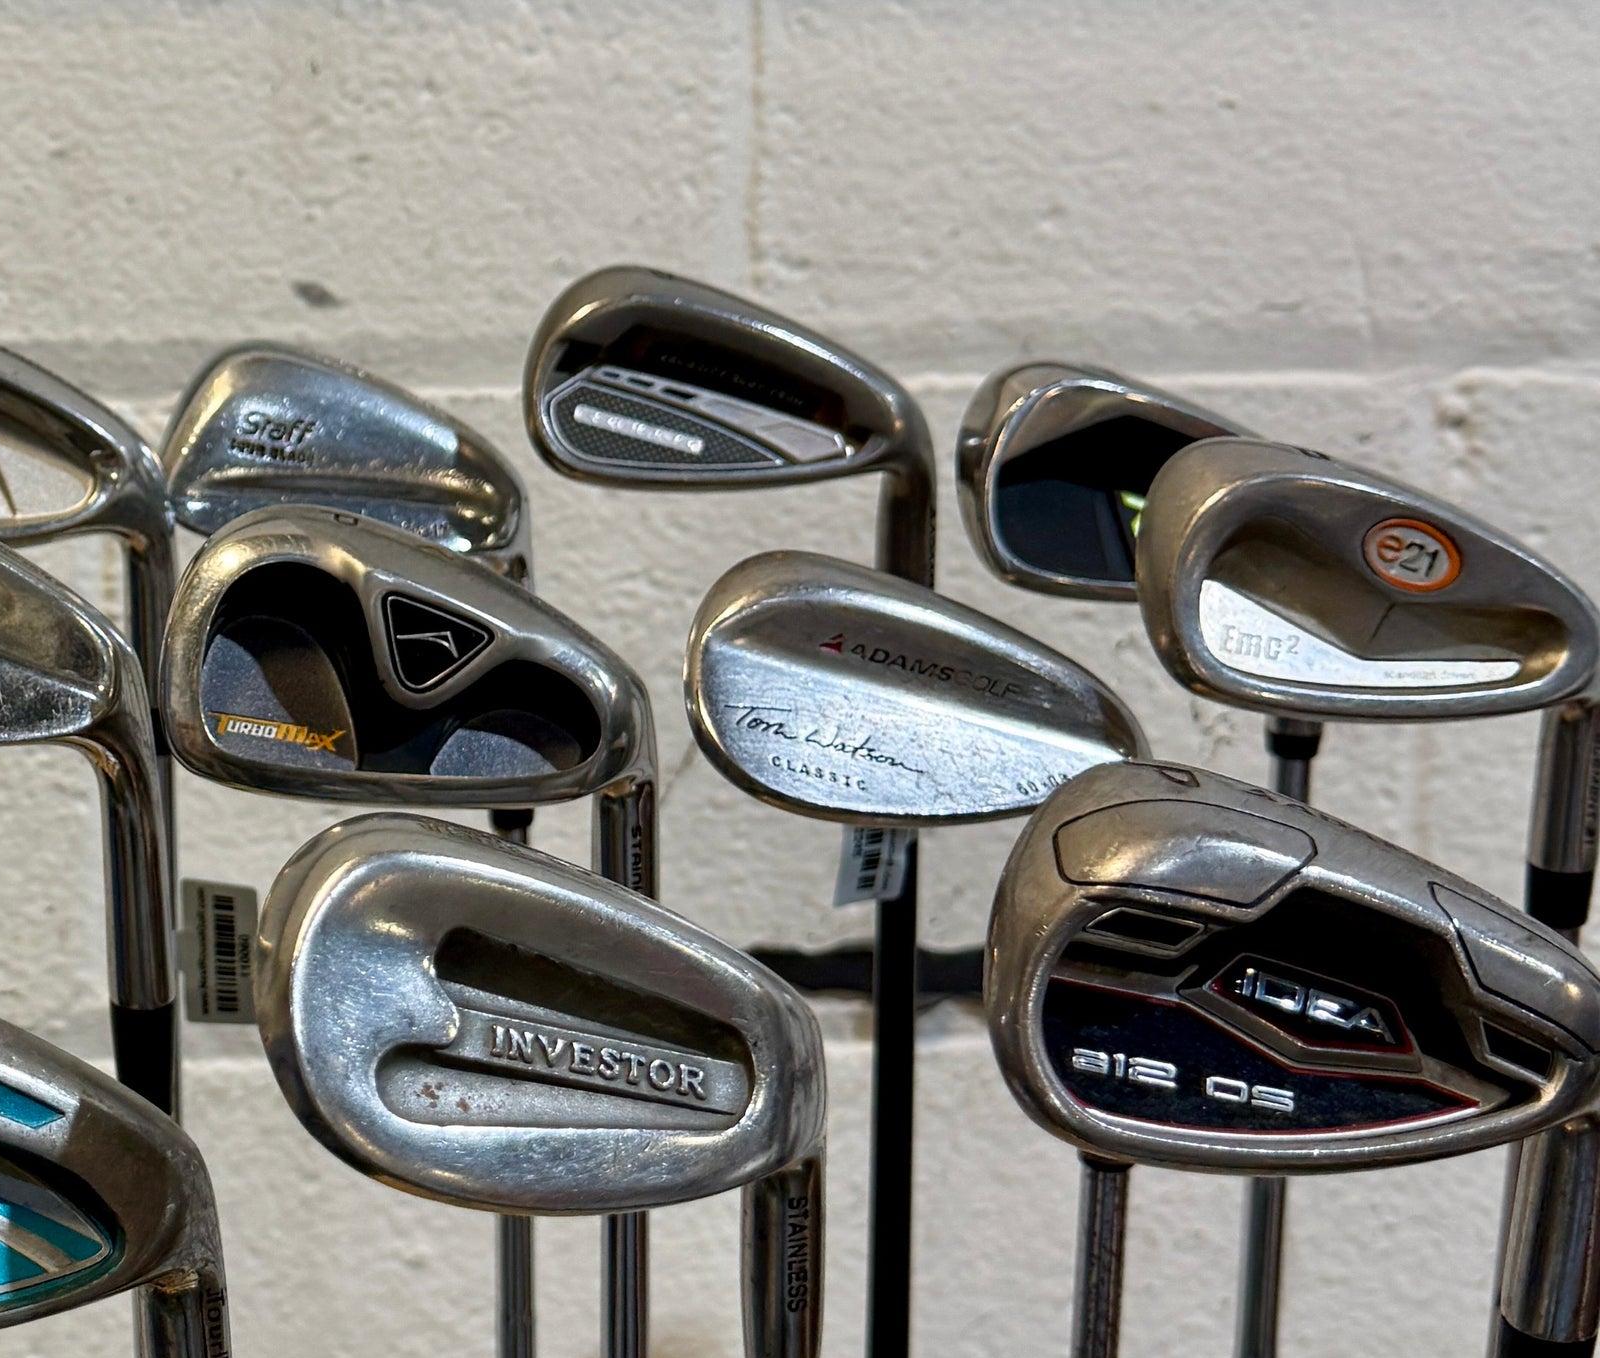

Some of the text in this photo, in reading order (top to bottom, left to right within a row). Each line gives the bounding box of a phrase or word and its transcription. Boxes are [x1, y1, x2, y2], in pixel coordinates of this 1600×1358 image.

[240, 411, 316, 444] Staff
[771, 755, 867, 792] CLASSIC
[490, 1024, 708, 1101] INVESTOR
[786, 1197, 809, 1314] STAINLESS
